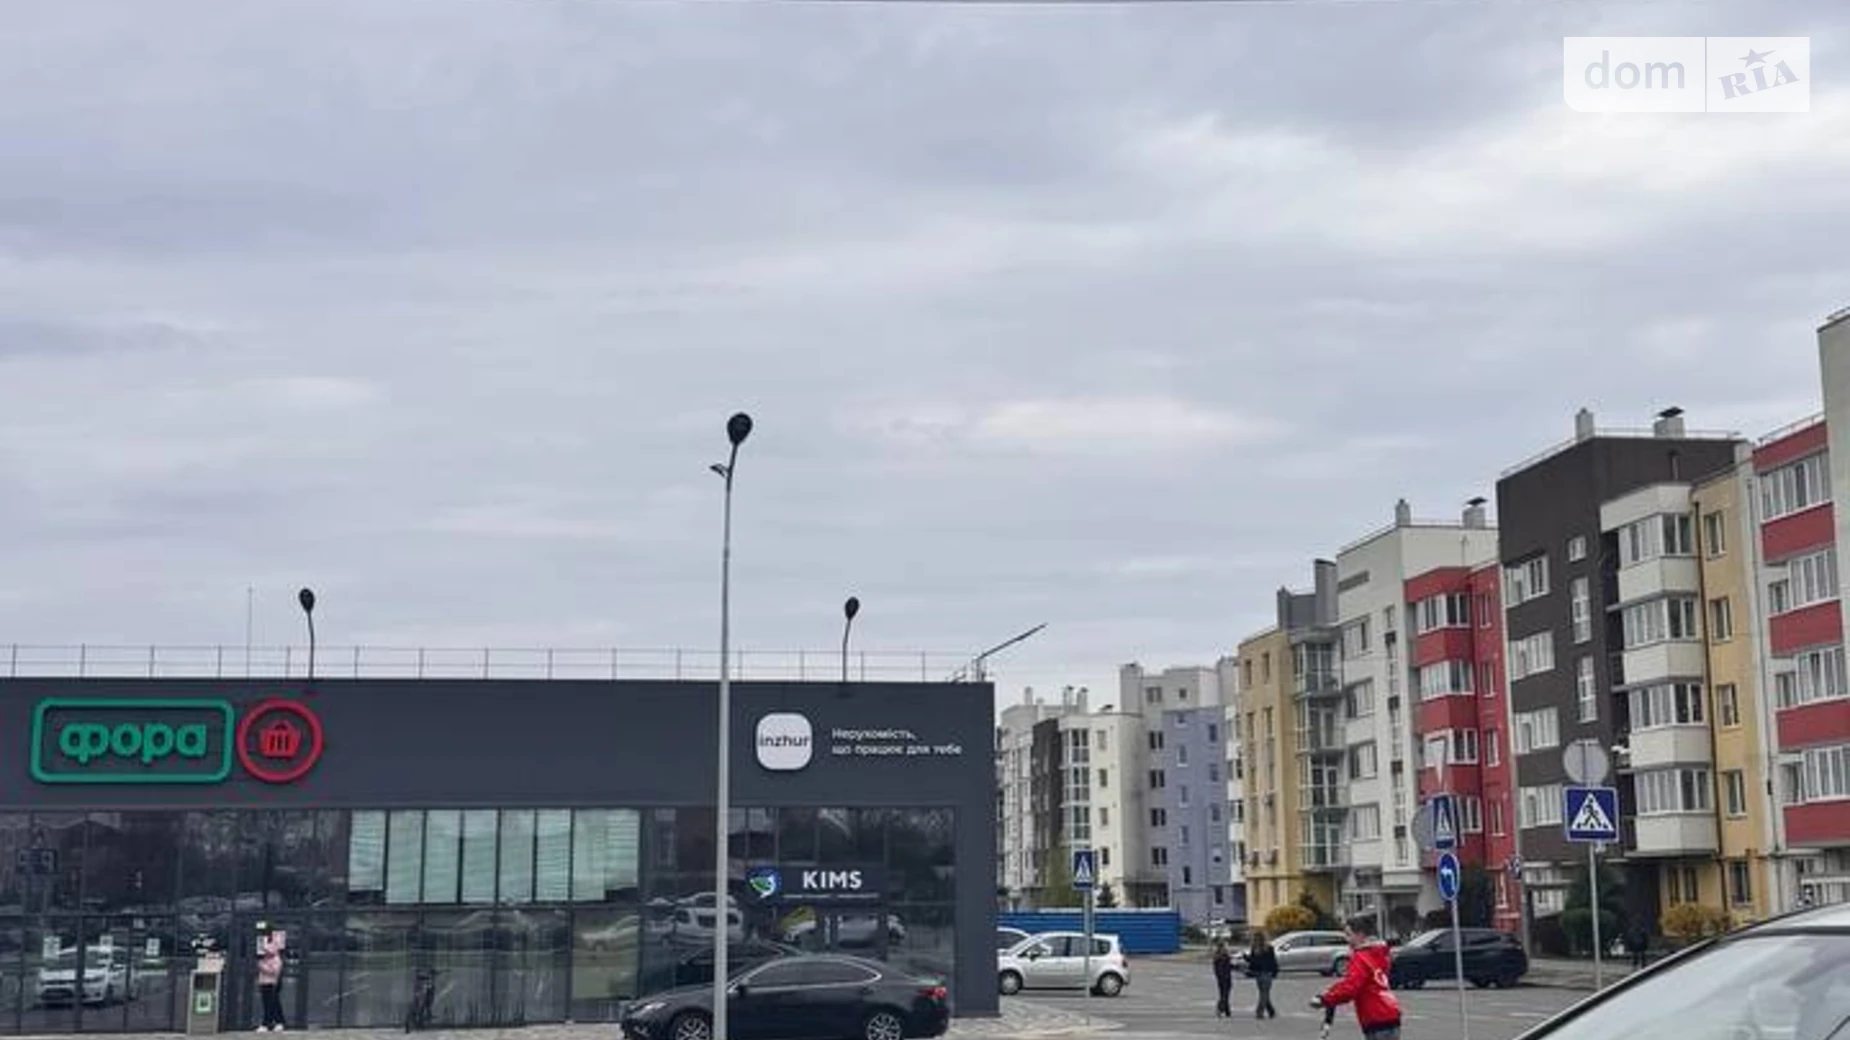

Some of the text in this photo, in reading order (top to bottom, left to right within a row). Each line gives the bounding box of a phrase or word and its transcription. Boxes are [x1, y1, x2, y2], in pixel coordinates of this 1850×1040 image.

[59, 722, 207, 764] фора
[759, 733, 811, 748] inzhur
[802, 870, 863, 889] KIMS
